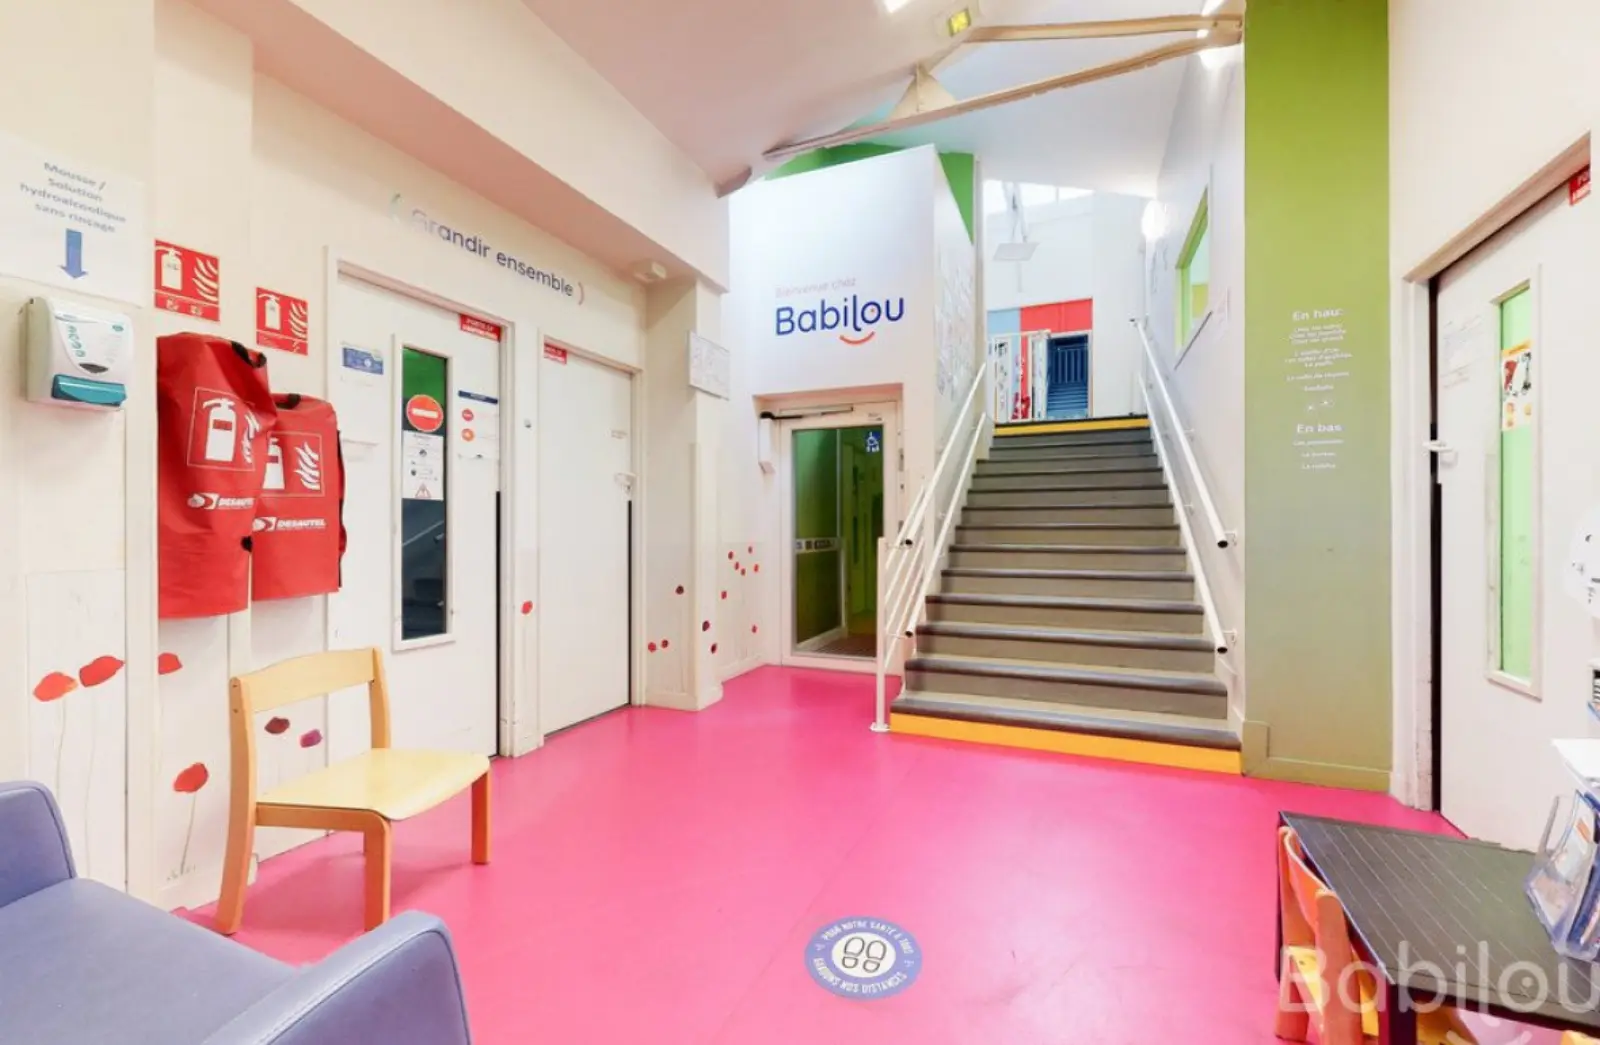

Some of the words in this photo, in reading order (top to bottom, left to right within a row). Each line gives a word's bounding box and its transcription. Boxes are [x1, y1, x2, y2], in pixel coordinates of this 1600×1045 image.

[44, 162, 97, 187] Mousse
[48, 177, 103, 202] Solution
[35, 203, 66, 218] sans
[496, 251, 574, 297] ensemble
[775, 294, 905, 336] Babilou
[1296, 424, 1314, 434] En
